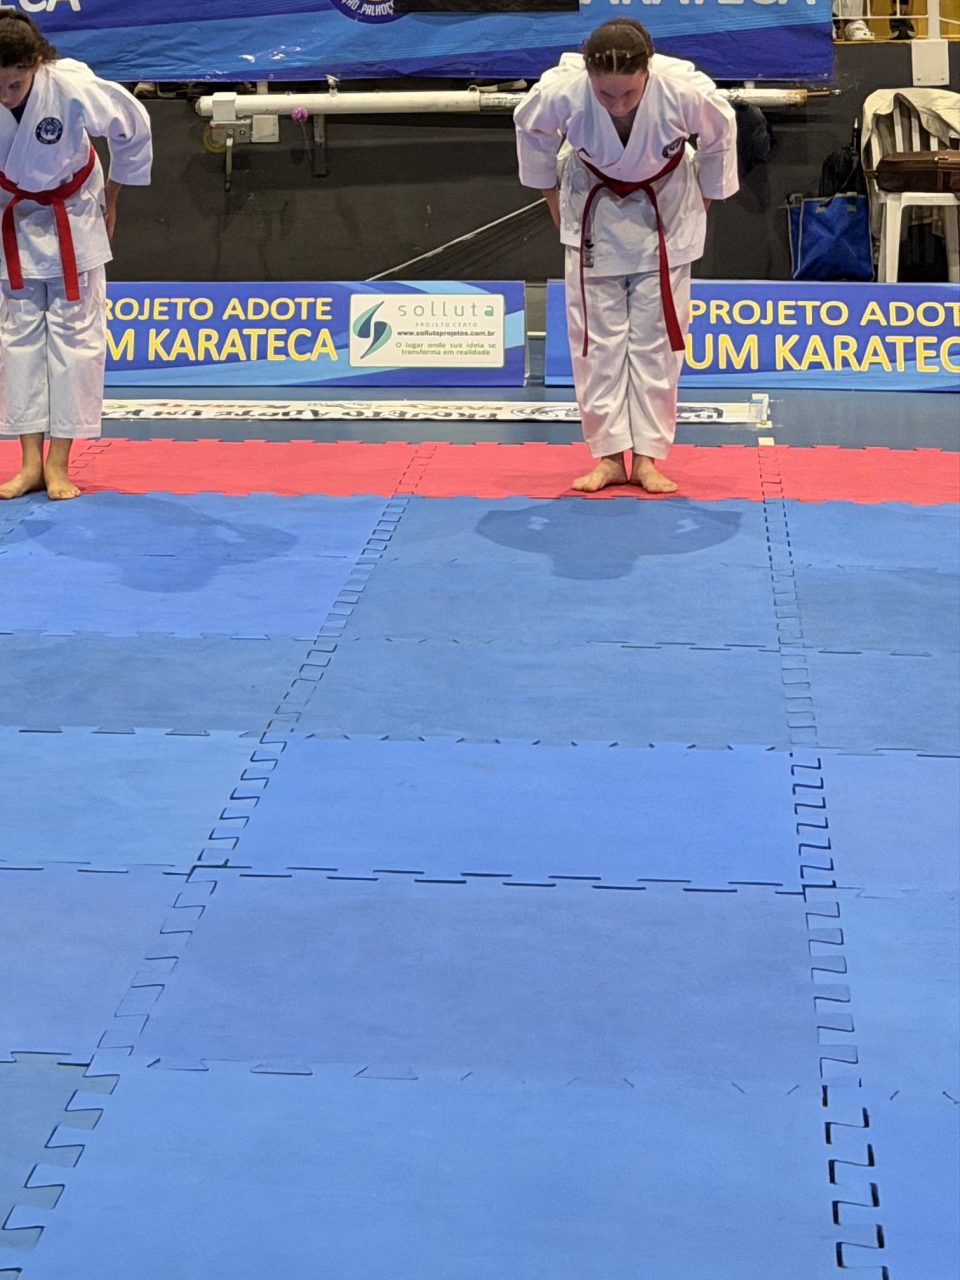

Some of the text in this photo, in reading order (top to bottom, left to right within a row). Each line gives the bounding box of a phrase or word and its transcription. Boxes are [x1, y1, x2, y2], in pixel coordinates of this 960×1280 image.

[360, 0, 394, 16] PALHOÇ
[105, 297, 332, 321] ROJETO ADOTE
[398, 301, 494, 317] solluta
[687, 299, 960, 327] PROJETO ADOT
[105, 327, 339, 362] M KARATECA
[685, 333, 960, 373] UM KARATEC
